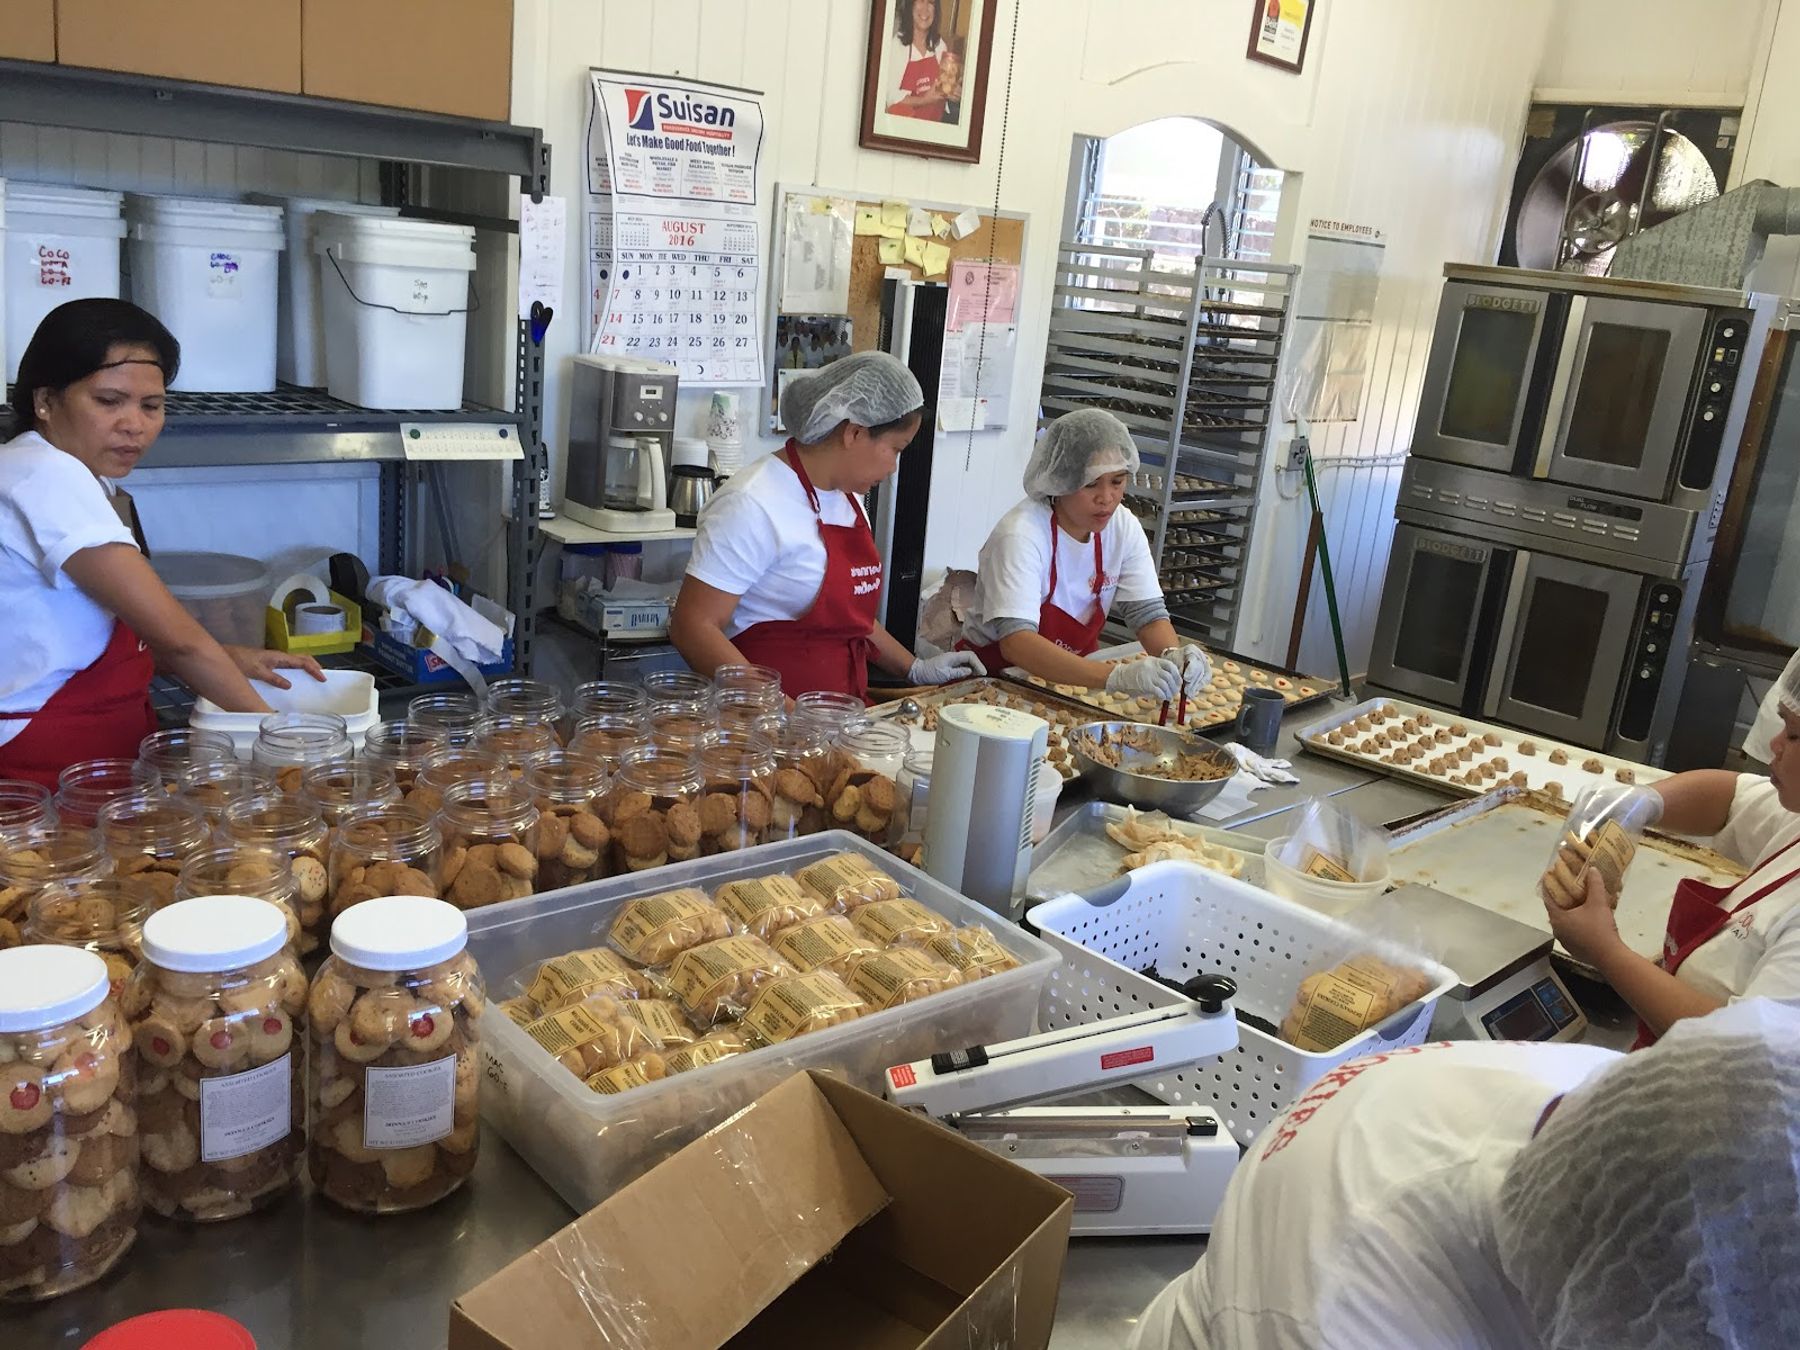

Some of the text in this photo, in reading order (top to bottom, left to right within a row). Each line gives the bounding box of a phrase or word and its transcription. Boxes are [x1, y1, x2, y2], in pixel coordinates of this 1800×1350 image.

[657, 93, 735, 127] Suisan
[627, 132, 641, 147] Let's
[642, 135, 663, 149] Make
[665, 137, 684, 151] Good
[686, 139, 702, 153] Food
[702, 141, 731, 157] Together
[662, 221, 706, 234] AUGUST
[1311, 219, 1331, 229] NOTICE
[1333, 221, 1340, 231] TO
[1341, 223, 1373, 235] EMPLOYEES
[669, 234, 695, 247] 2016
[671, 253, 686, 261] WED
[694, 254, 710, 262] THU
[638, 265, 744, 278] 1 2 3 4 5 6
[593, 289, 600, 300] 4
[614, 289, 748, 301] 7 8 9 10 11 12 13
[1467, 294, 1535, 312] BLODGETT
[609, 313, 748, 324] 14 15 16 17 18 19 20
[601, 334, 748, 347] 21 22 23 24 25 26 27
